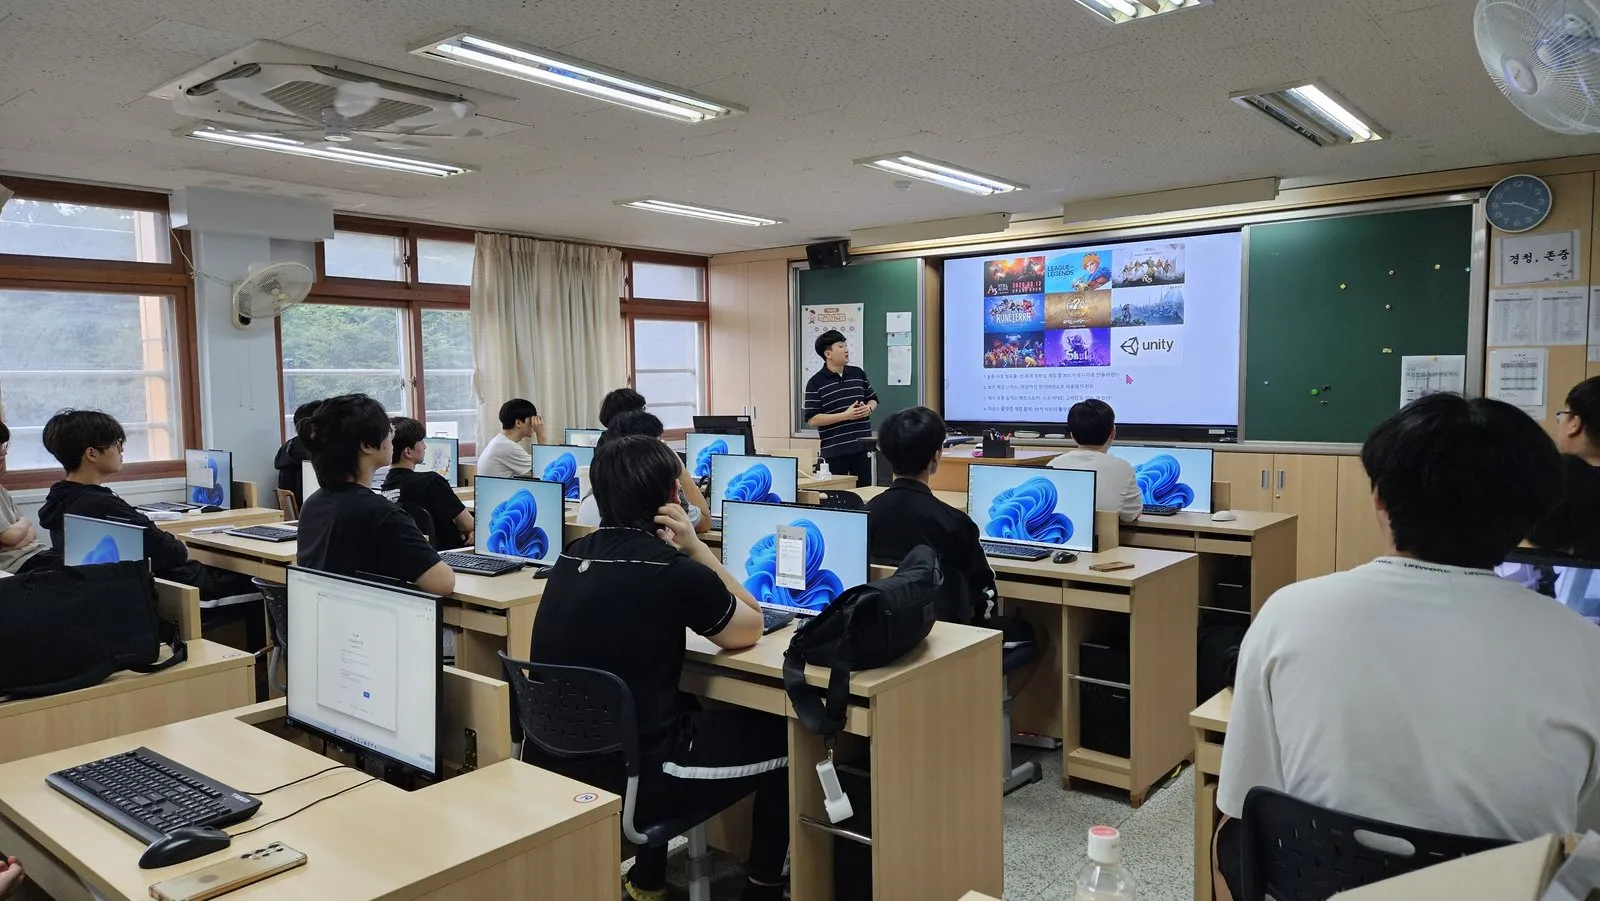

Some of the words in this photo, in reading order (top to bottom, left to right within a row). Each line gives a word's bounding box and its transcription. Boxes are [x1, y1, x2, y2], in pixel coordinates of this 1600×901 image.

[1543, 249, 1570, 262] 존중
[1047, 264, 1070, 272] LEAGUE
[996, 313, 1031, 323] RUNETERRA
[1142, 338, 1174, 352] unity
